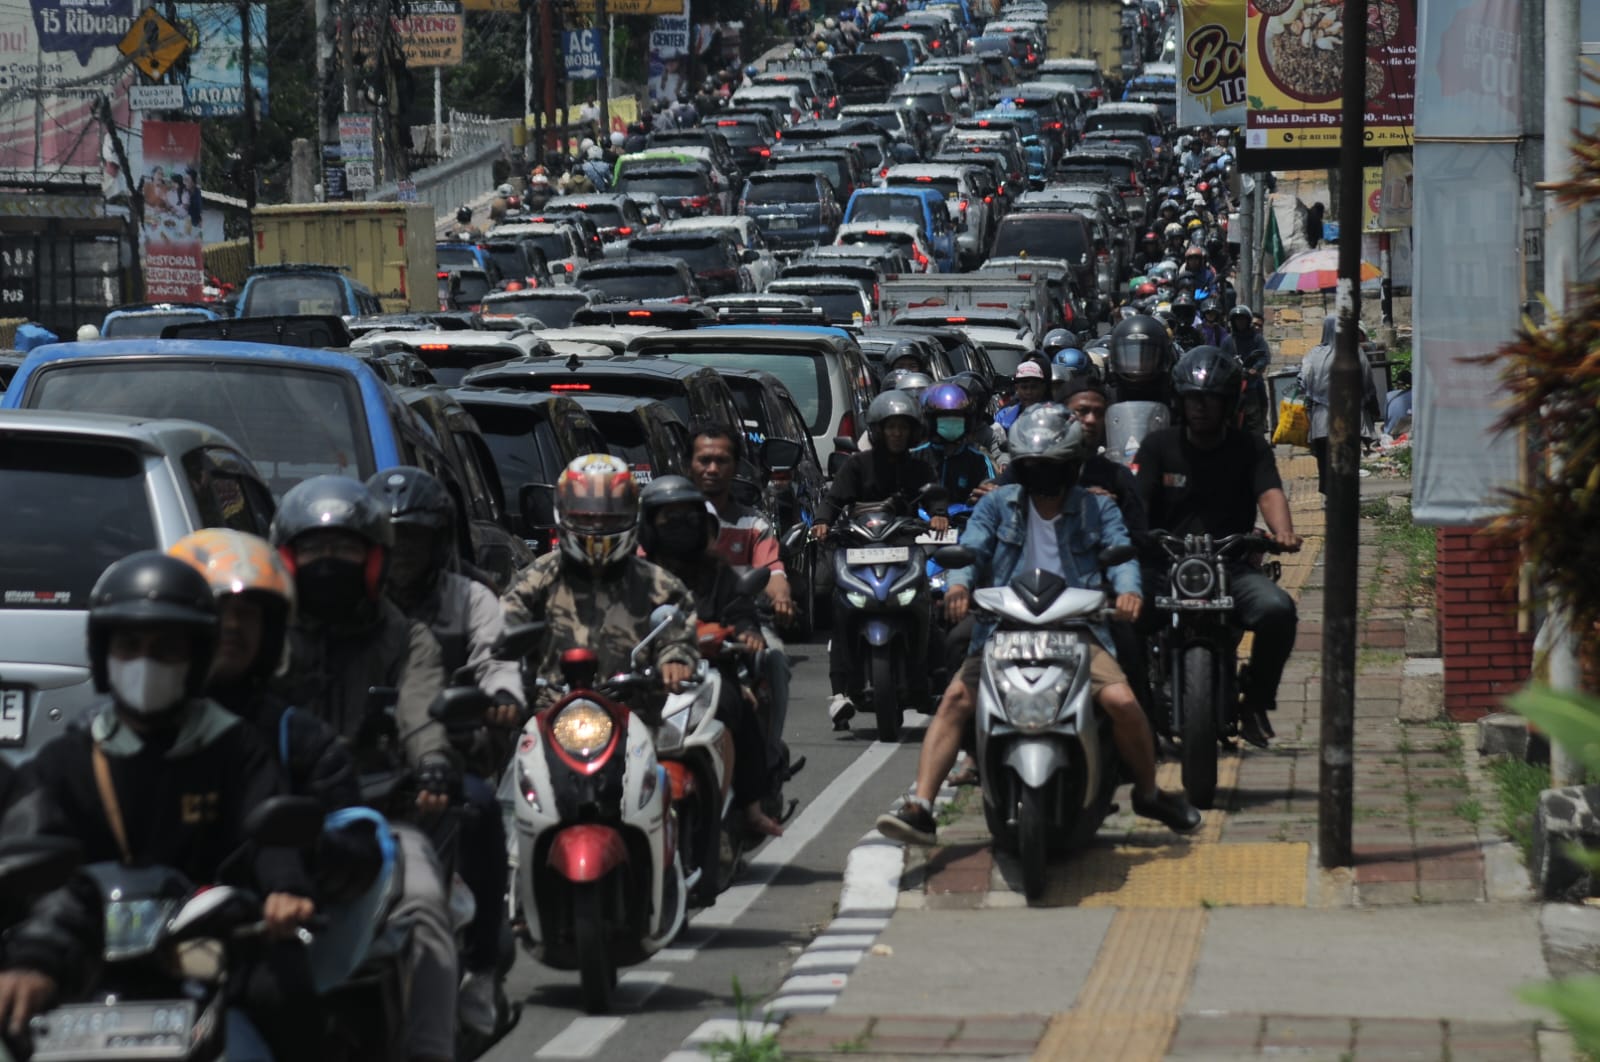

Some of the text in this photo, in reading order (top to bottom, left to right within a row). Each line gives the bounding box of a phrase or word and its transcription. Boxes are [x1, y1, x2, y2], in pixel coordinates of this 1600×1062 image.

[40, 8, 61, 33] 15
[569, 30, 595, 53] AC
[653, 32, 686, 47] CENTER
[564, 53, 601, 67] MOBIL
[1256, 113, 1288, 124] Mulai
[1291, 113, 1318, 123] Dari
[1320, 113, 1336, 124] Rp
